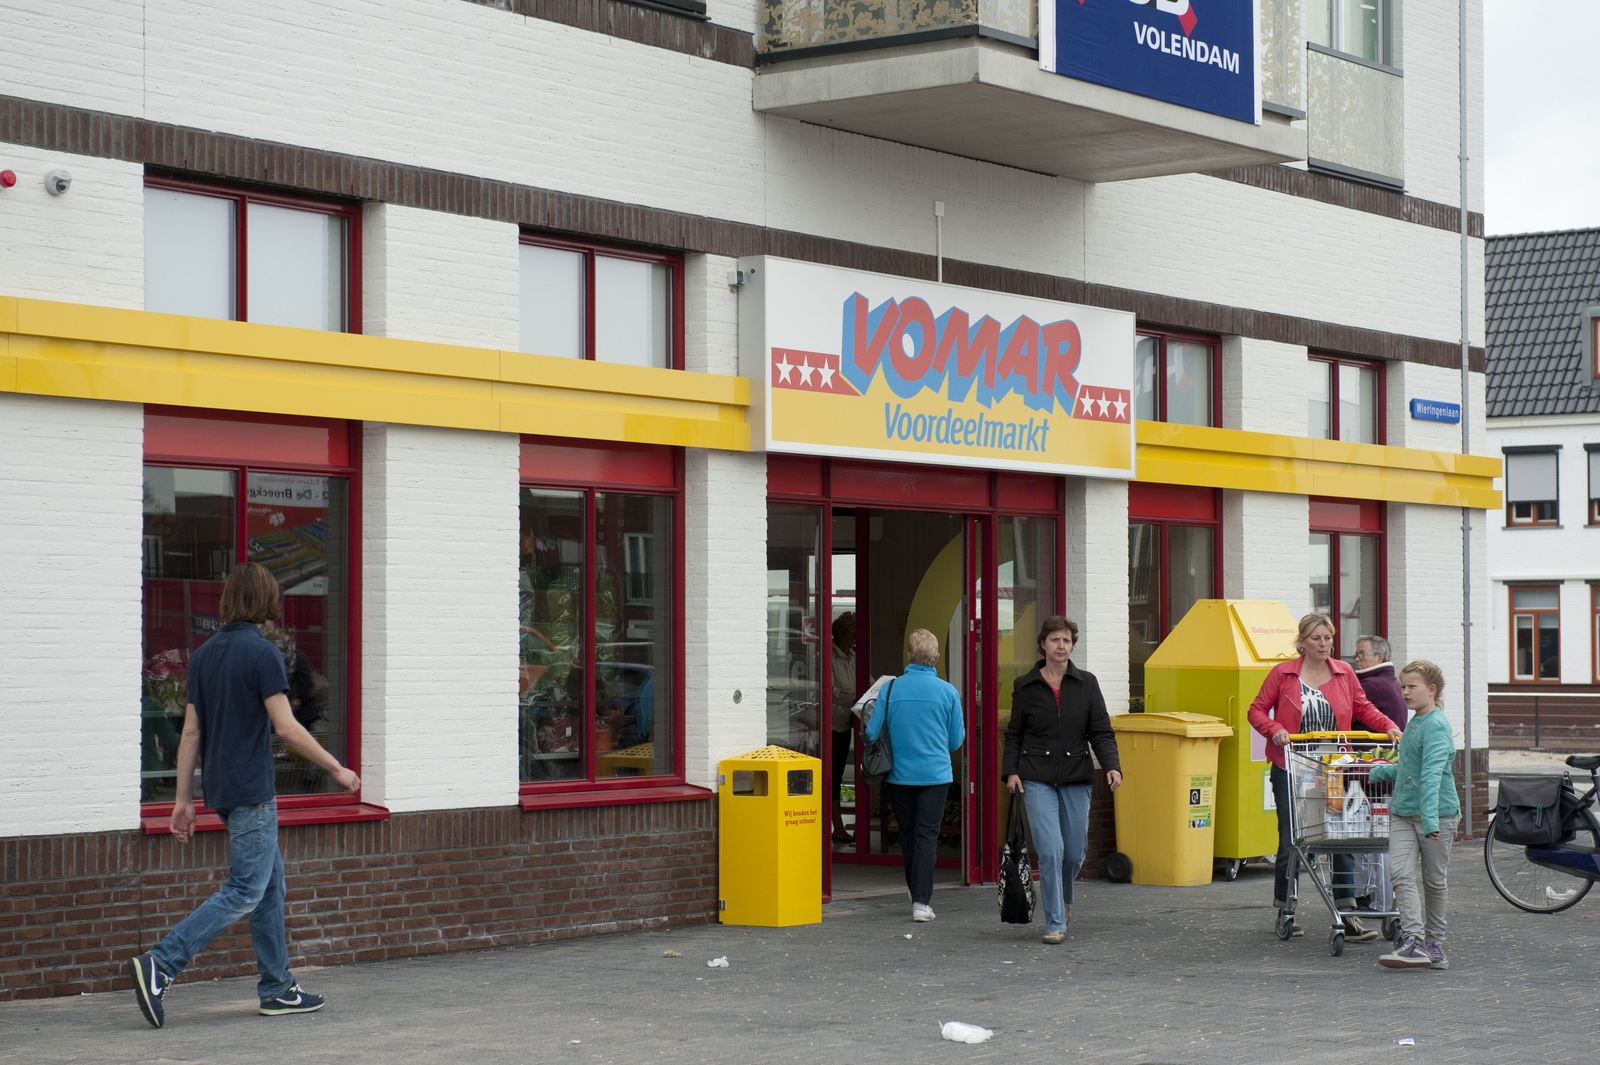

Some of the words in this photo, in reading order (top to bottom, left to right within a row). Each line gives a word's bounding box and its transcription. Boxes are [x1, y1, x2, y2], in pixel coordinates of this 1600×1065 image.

[1133, 21, 1240, 75] VOLENDAM
[841, 291, 1082, 418] VOMAR
[885, 402, 1050, 453] Voordeelmarkt
[1416, 402, 1459, 419] Wieringenlaan
[784, 810, 792, 818] Wij
